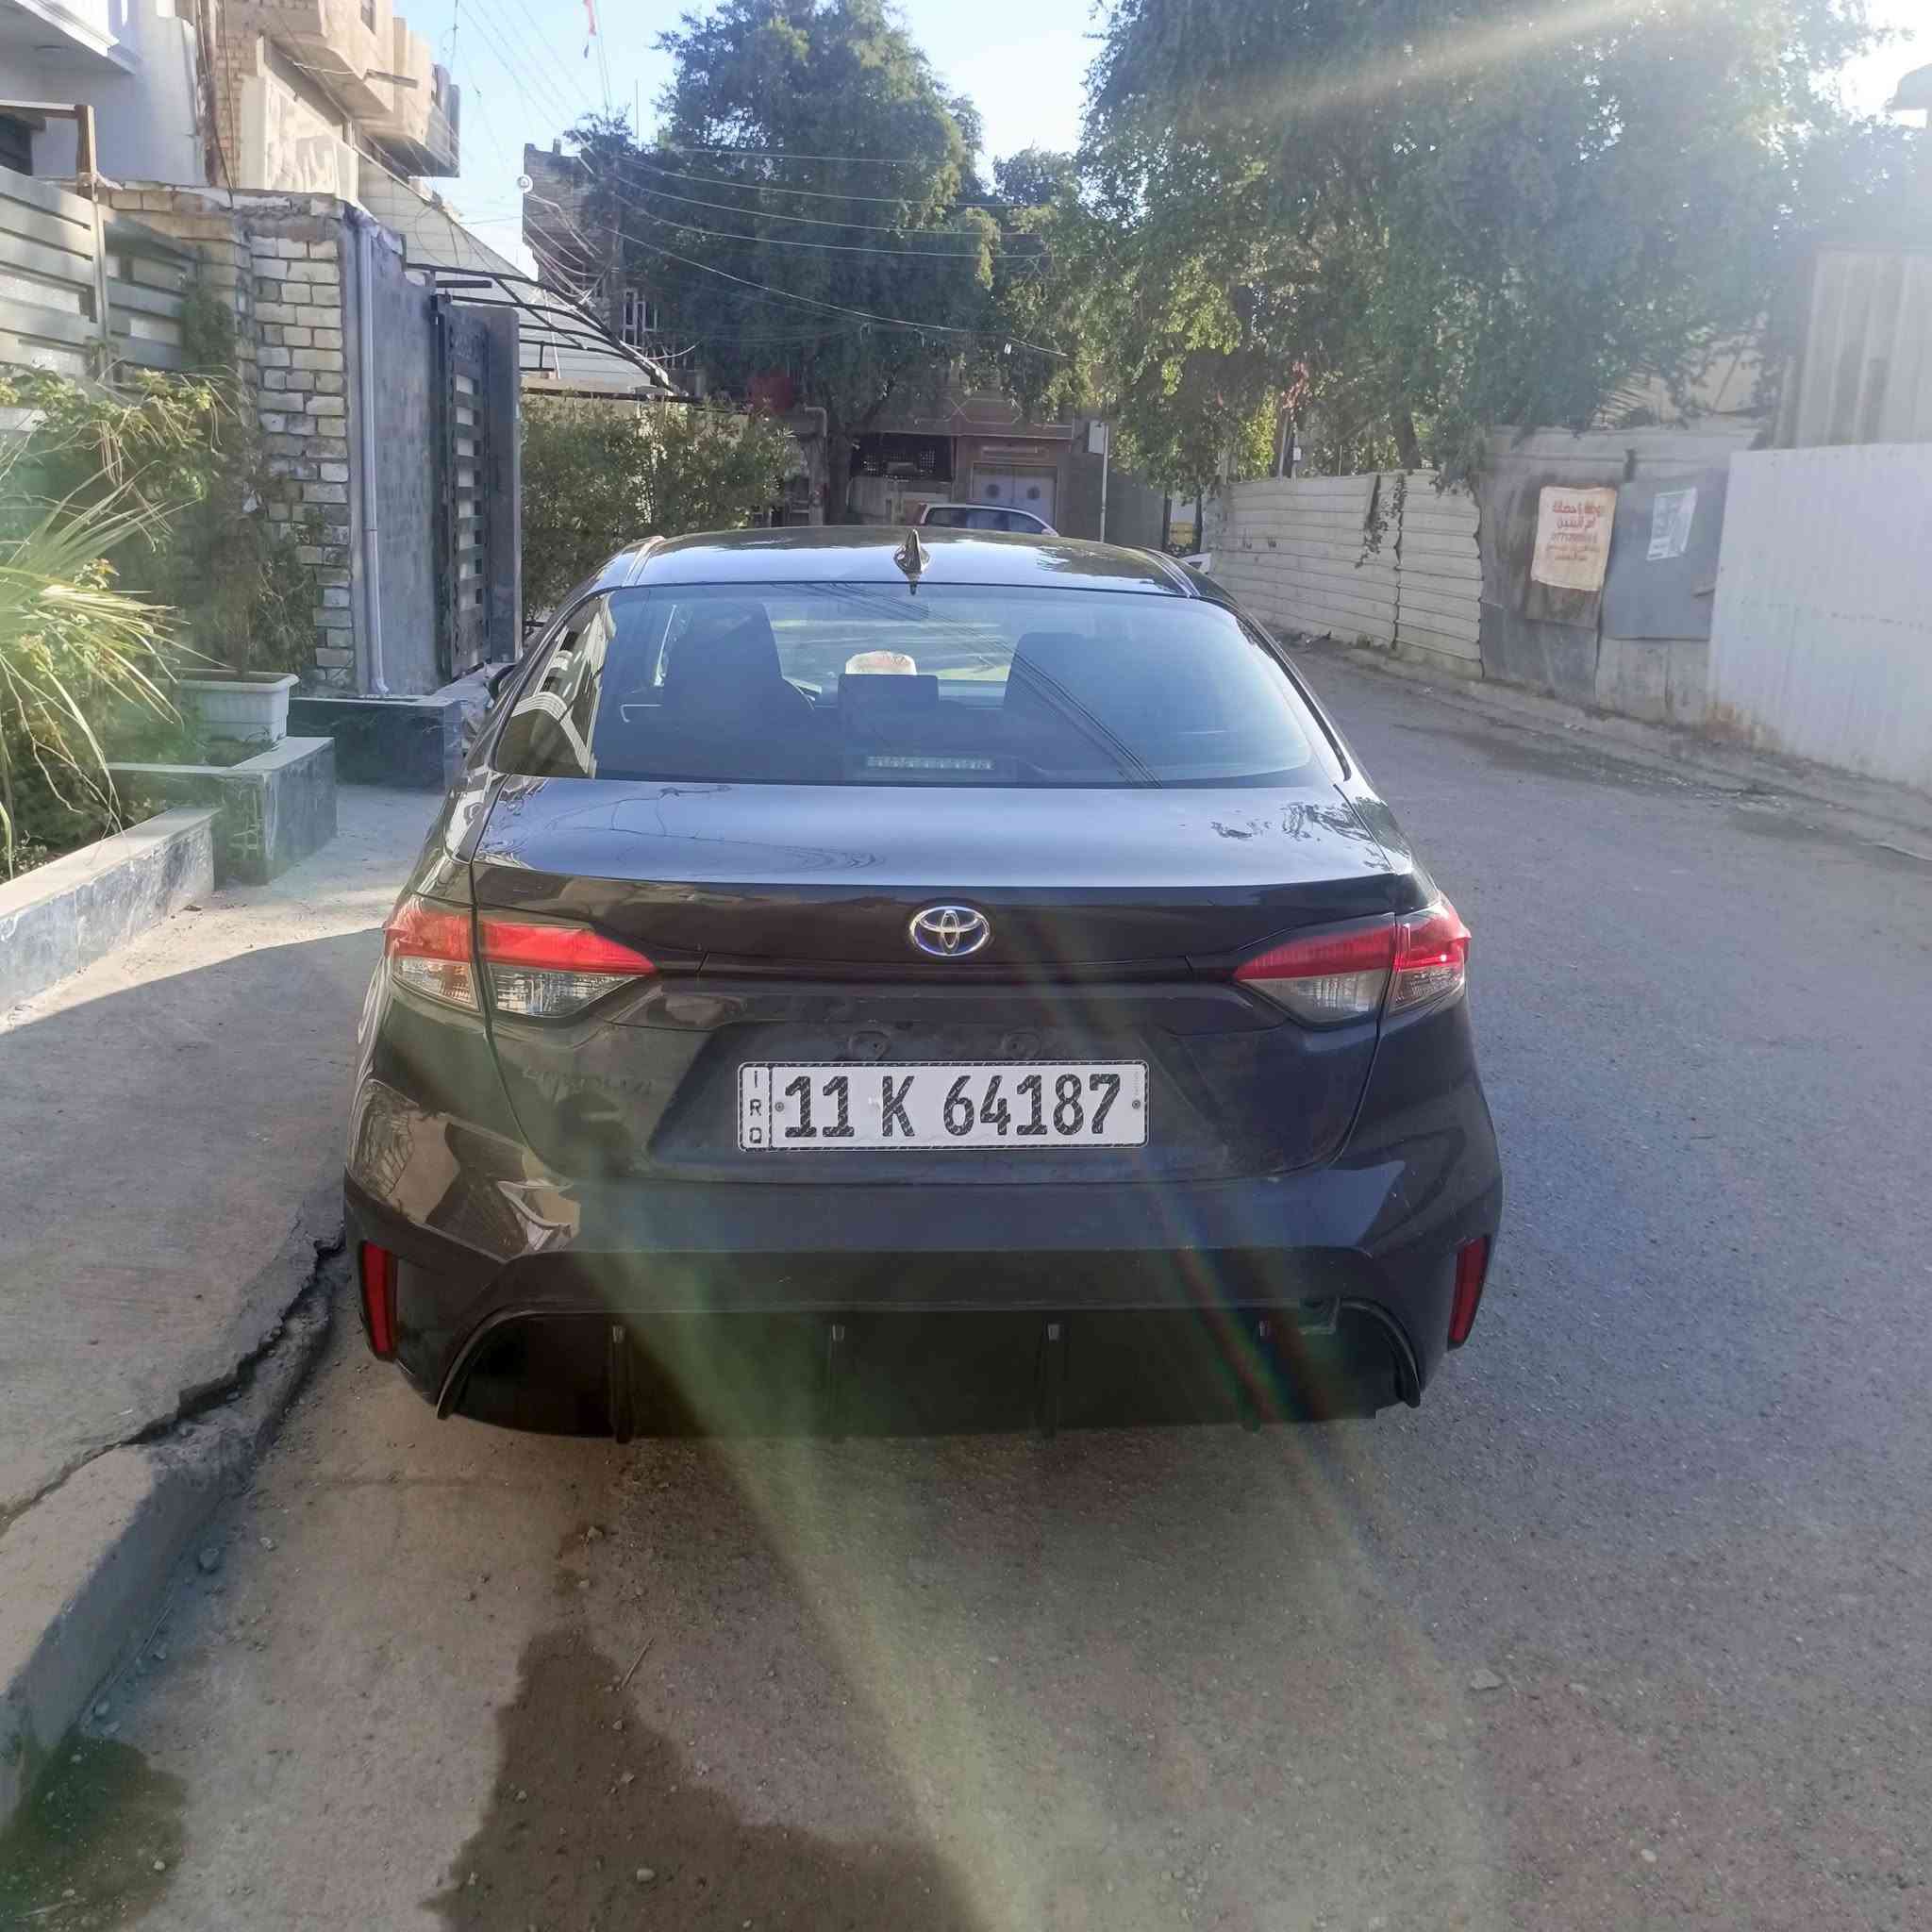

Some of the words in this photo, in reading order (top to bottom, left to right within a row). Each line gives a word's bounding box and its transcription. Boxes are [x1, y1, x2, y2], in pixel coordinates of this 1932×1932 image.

[785, 1075, 855, 1138] 11
[881, 1075, 915, 1137] K
[943, 1074, 1122, 1136] 64187
